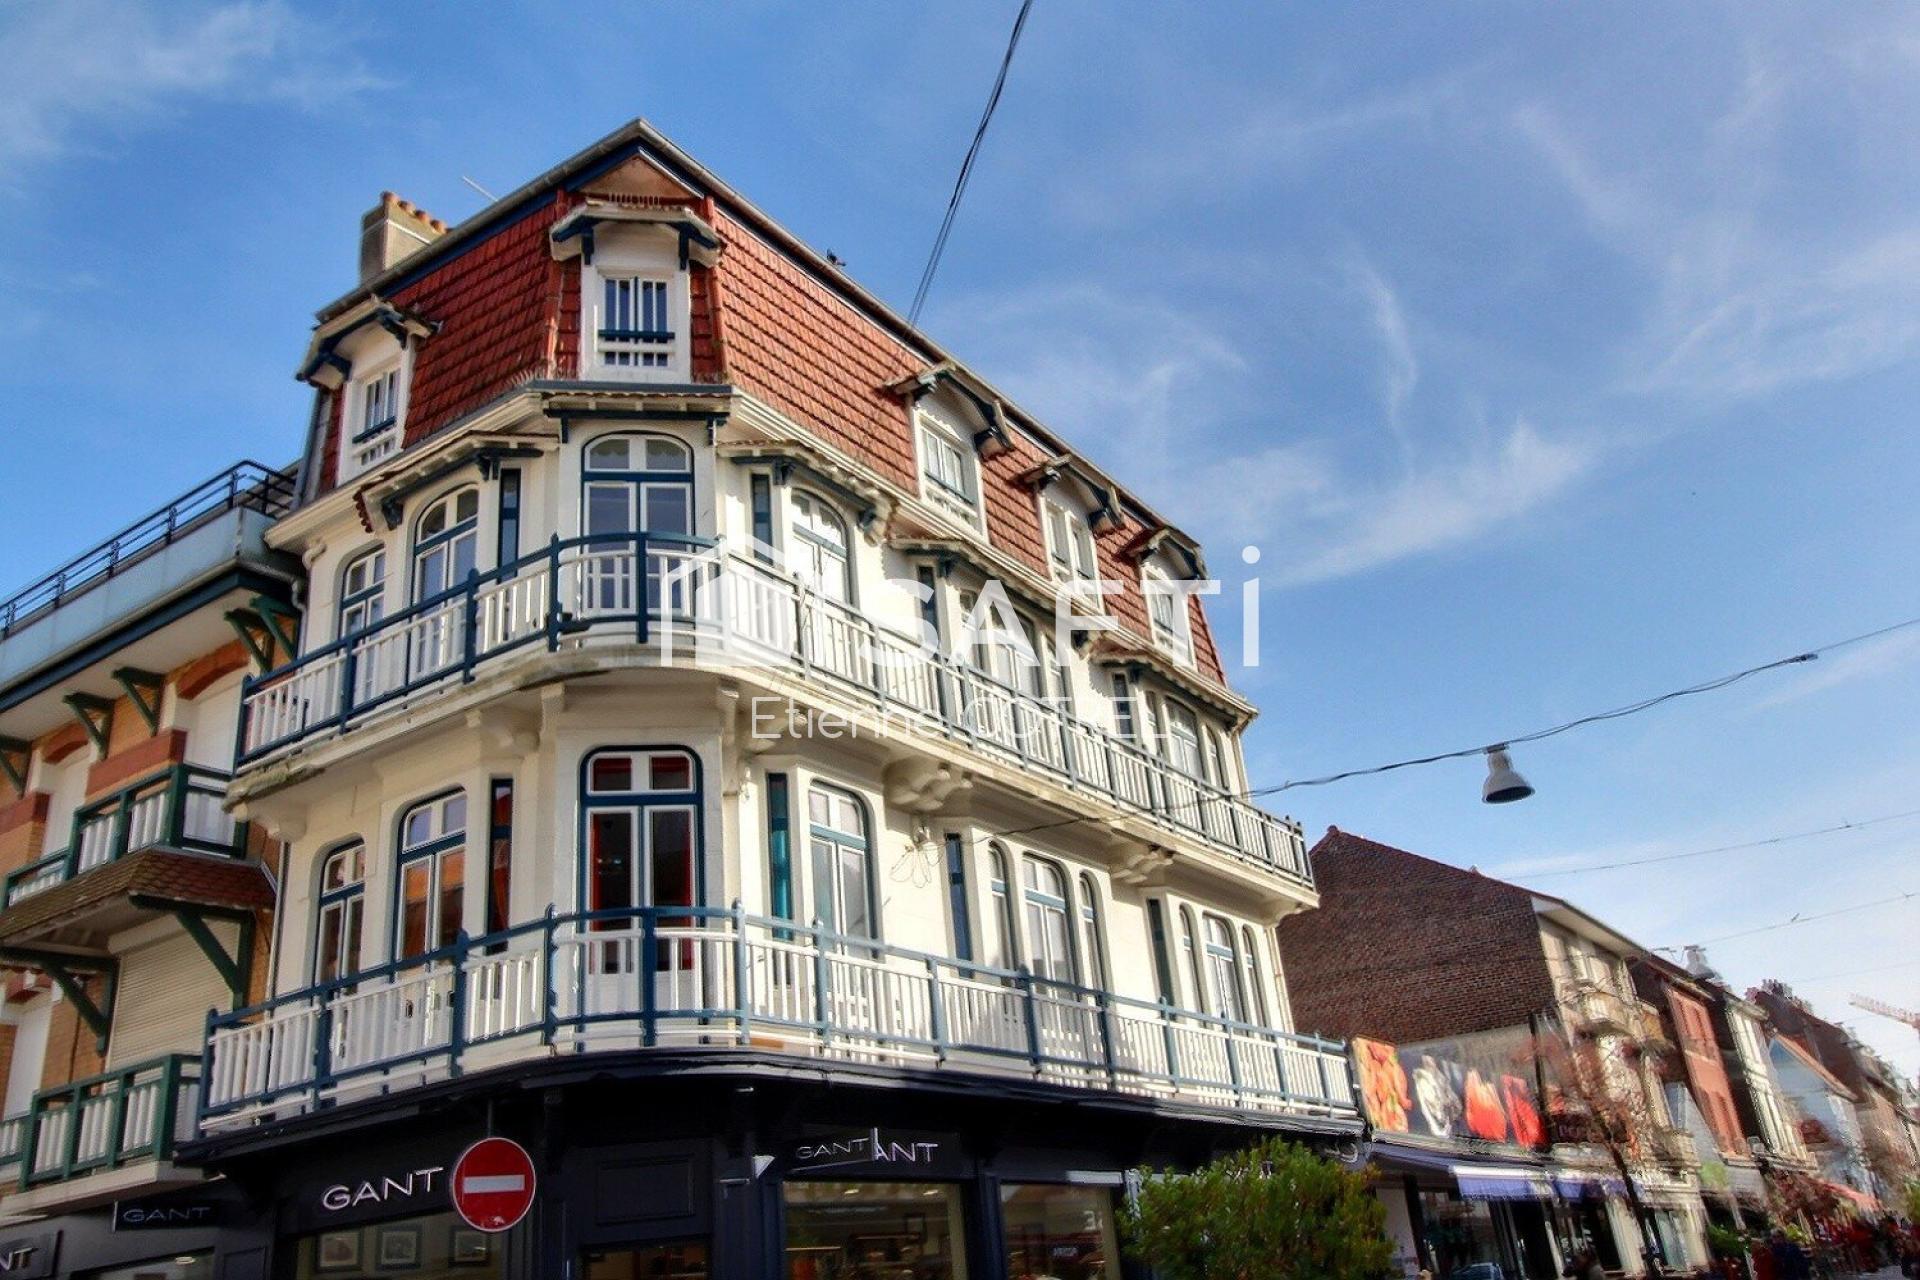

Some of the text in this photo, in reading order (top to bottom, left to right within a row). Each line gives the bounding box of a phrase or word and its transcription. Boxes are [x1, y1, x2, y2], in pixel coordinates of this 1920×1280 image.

[795, 1137, 869, 1159] GANT
[322, 1166, 444, 1211] GANT
[122, 1206, 211, 1223] GANT
